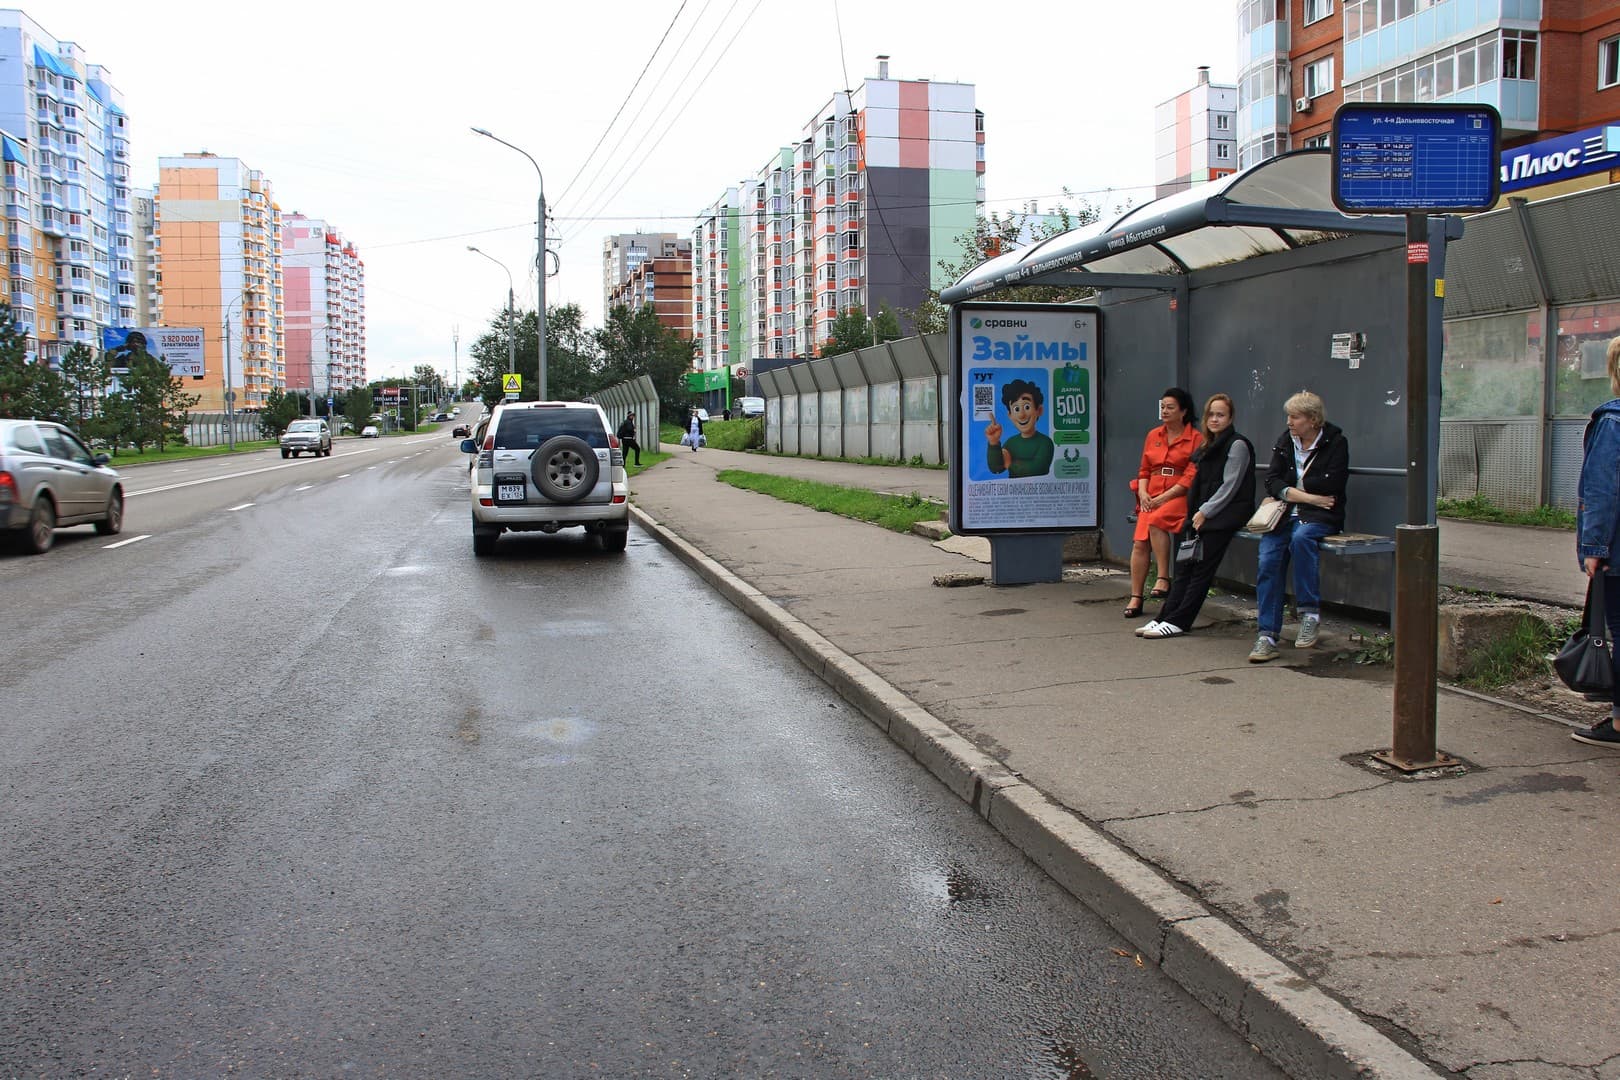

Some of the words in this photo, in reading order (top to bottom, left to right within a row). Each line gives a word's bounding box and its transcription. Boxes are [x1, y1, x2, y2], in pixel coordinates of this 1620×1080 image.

[1511, 148, 1581, 180] Плюс
[1107, 238, 1126, 251] улица
[1126, 225, 1167, 244] Абытаевская
[985, 320, 1027, 329] сравни
[1074, 320, 1087, 329] 6+
[972, 335, 1087, 361] Займы
[974, 373, 994, 382] тут
[1056, 394, 1085, 416] 500
